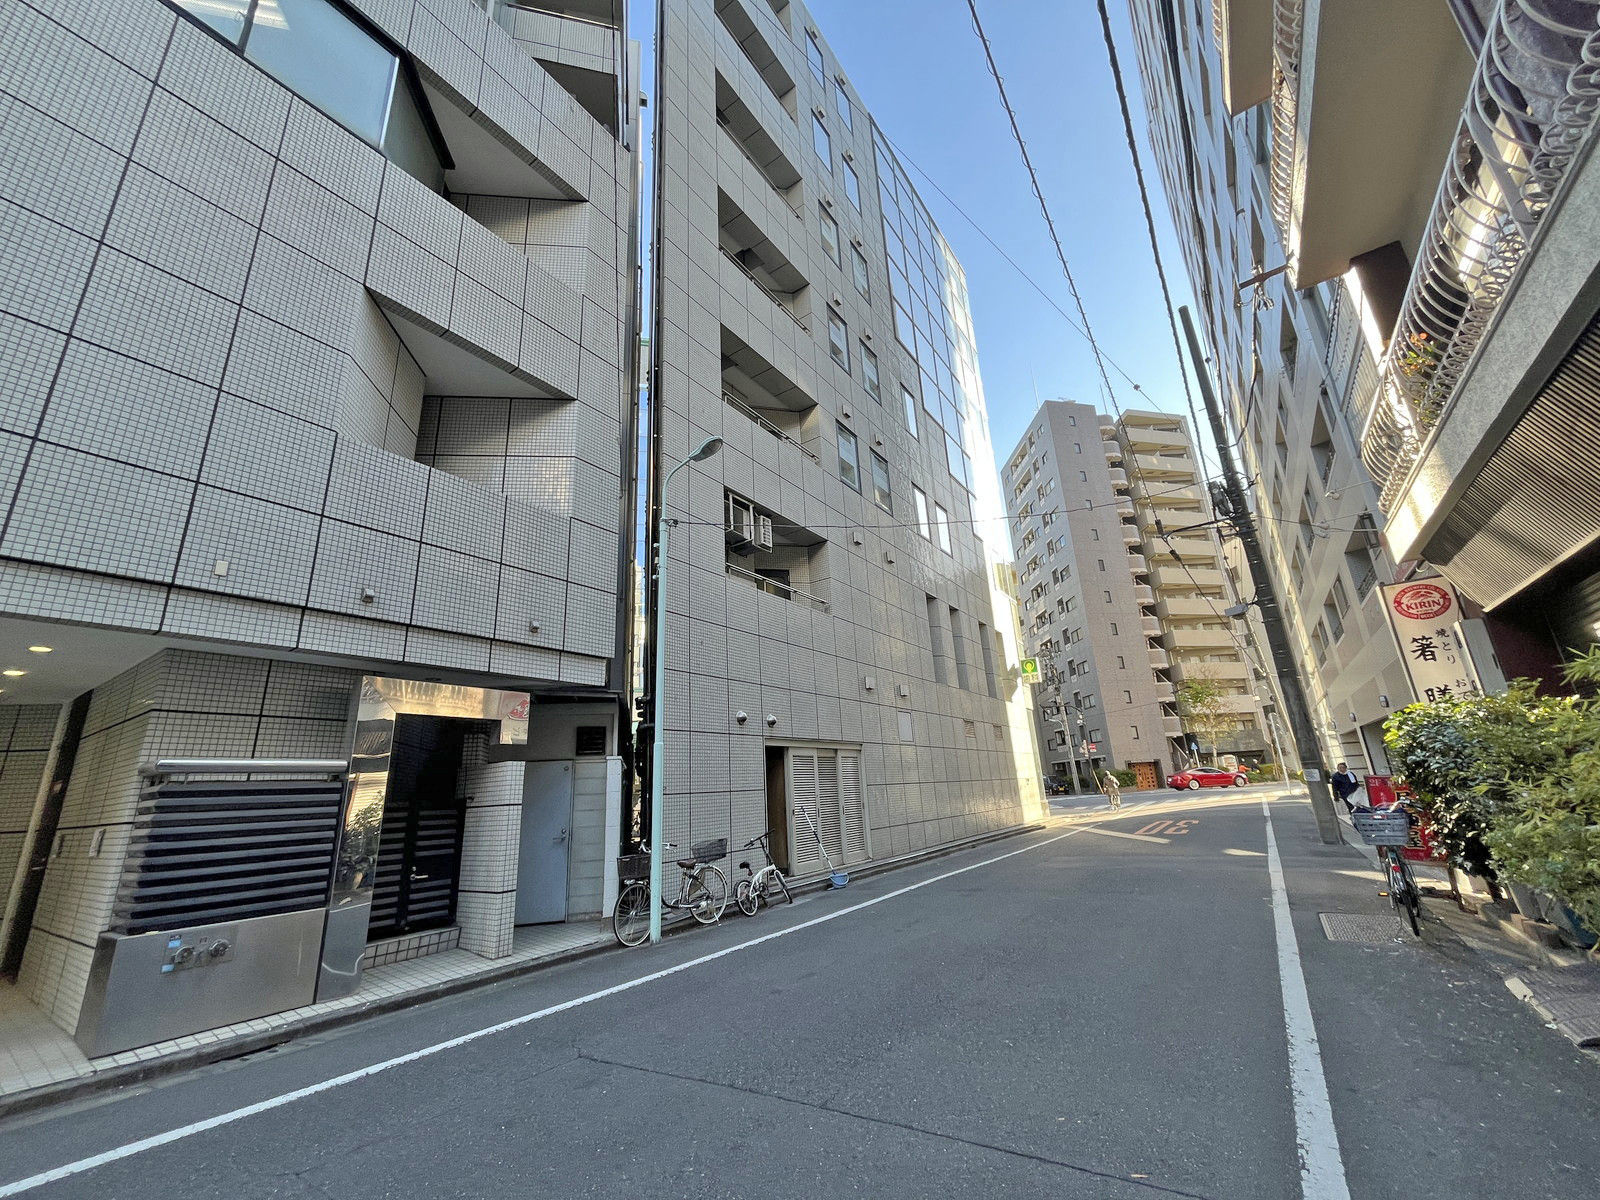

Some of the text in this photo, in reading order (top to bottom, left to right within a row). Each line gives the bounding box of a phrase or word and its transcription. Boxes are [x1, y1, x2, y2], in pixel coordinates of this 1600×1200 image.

[1405, 599, 1441, 611] KIRIN
[1435, 628, 1456, 664] 焼とり
[1133, 820, 1200, 835] 30
